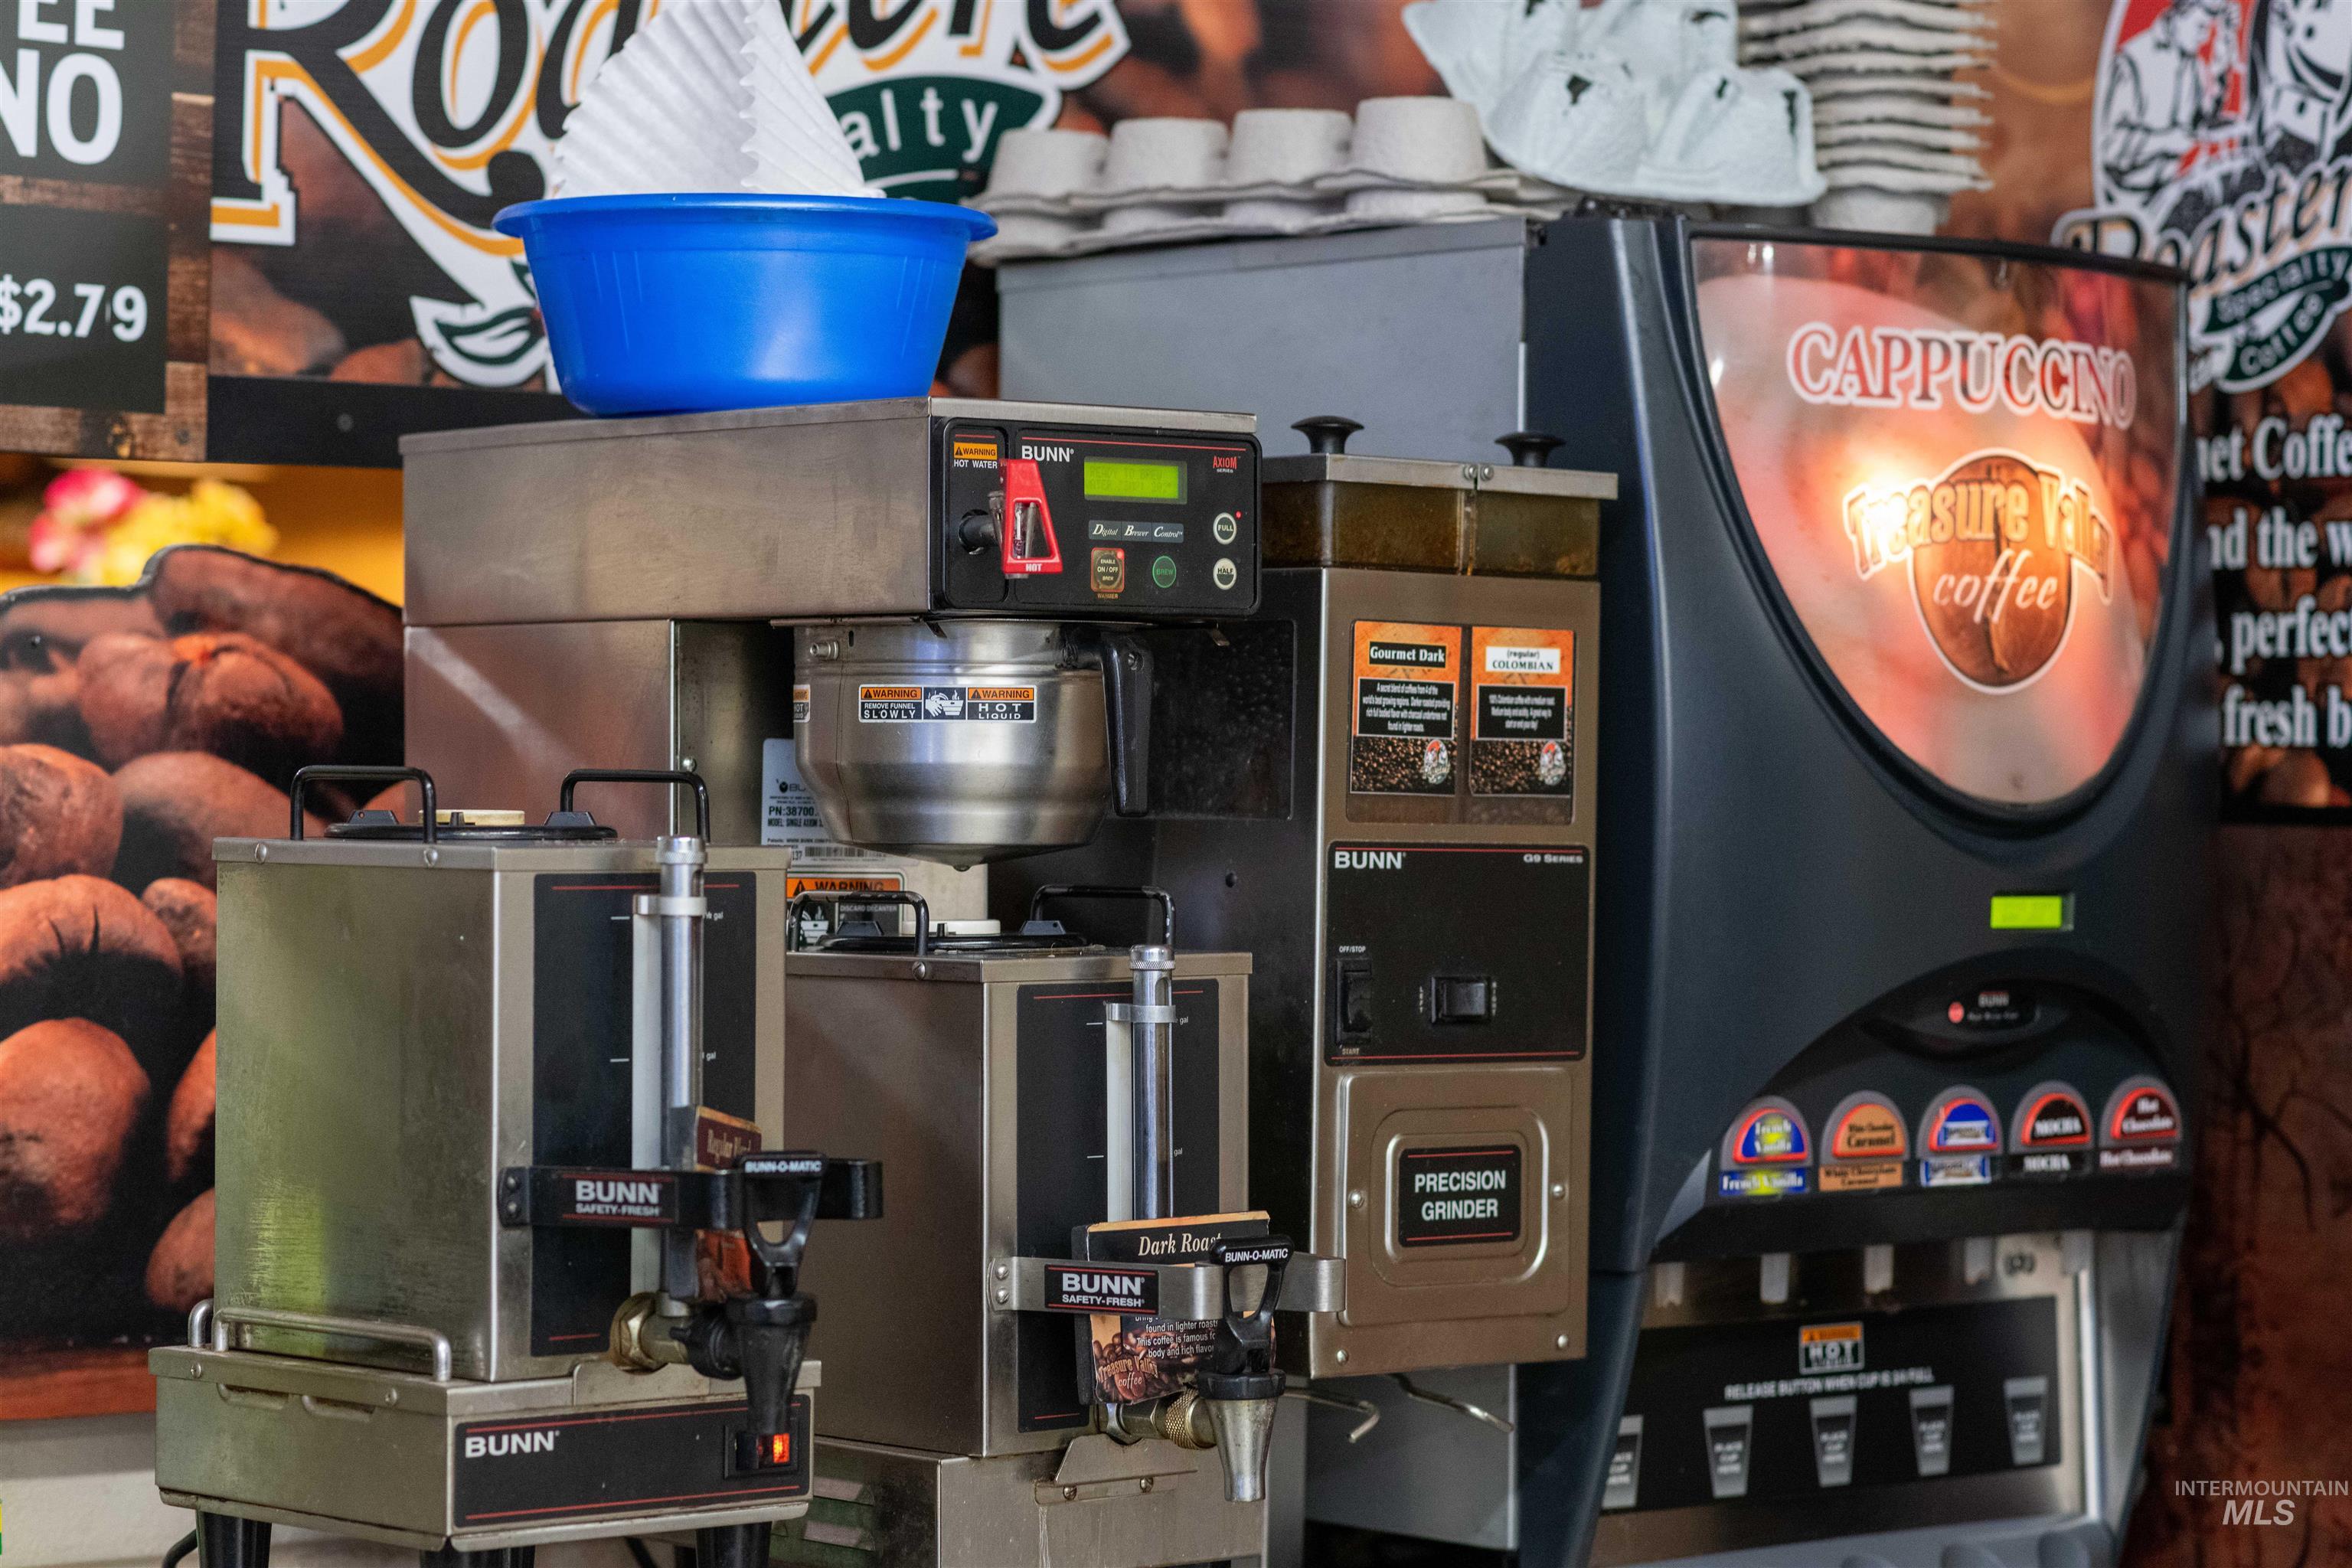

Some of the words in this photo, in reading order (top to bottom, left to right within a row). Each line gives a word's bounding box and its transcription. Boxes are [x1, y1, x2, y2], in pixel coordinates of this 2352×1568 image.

[840, 87, 999, 164] alty
[0, 273, 148, 342] $2.79
[1787, 322, 2138, 430] CAPPUCCINO
[962, 447, 995, 456] WARNING
[1021, 445, 1070, 462] BUNN
[953, 459, 969, 468] HOT
[972, 459, 998, 469] WATER
[1213, 456, 1237, 469] AXIOM
[1092, 523, 1119, 537] Digital
[1124, 524, 1149, 537] Brewer
[2256, 505, 2319, 569] the
[1025, 563, 1042, 572] HOT
[1932, 548, 2059, 625] coffee
[1370, 646, 1416, 662] Gourmet
[1419, 648, 1446, 663] Dark
[1492, 660, 1553, 671] COLOMBIAN
[873, 689, 917, 698] WARNING
[982, 690, 1030, 698] WARNING
[864, 710, 916, 719] SLOWLY
[978, 703, 1021, 712] HOT
[2223, 683, 2318, 748] fresh
[1334, 851, 1403, 870] BUNN
[744, 1160, 822, 1173] BUNN-O-MATIC
[1414, 1170, 1506, 1193] PRECISION
[576, 1180, 659, 1204] BUNN
[575, 1203, 660, 1217] SAFETY-FRESH
[1422, 1198, 1498, 1221] GRINDER
[1138, 1233, 1177, 1256] Dark
[1225, 1248, 1289, 1263] BUNN-O-MATIC
[1062, 1272, 1142, 1295] BUNN
[1062, 1294, 1142, 1308] SAFETY-FRESH
[1145, 1323, 1166, 1334] found
[1167, 1322, 1174, 1331] in
[1175, 1321, 1197, 1333] lighter
[1136, 1337, 1152, 1347] This
[1153, 1335, 1174, 1346] coffee
[1175, 1334, 1182, 1344] is
[1183, 1332, 1208, 1343] famous
[1148, 1348, 1165, 1360] body
[1166, 1347, 1180, 1357] and
[1181, 1344, 1194, 1355] rich
[1808, 1341, 1854, 1361] HOT
[1098, 1357, 1133, 1383] Treasure
[1134, 1355, 1158, 1378] Valley
[1118, 1371, 1142, 1390] coffee
[1724, 1380, 1777, 1401] RELEASE
[466, 1430, 555, 1459] BUNN
